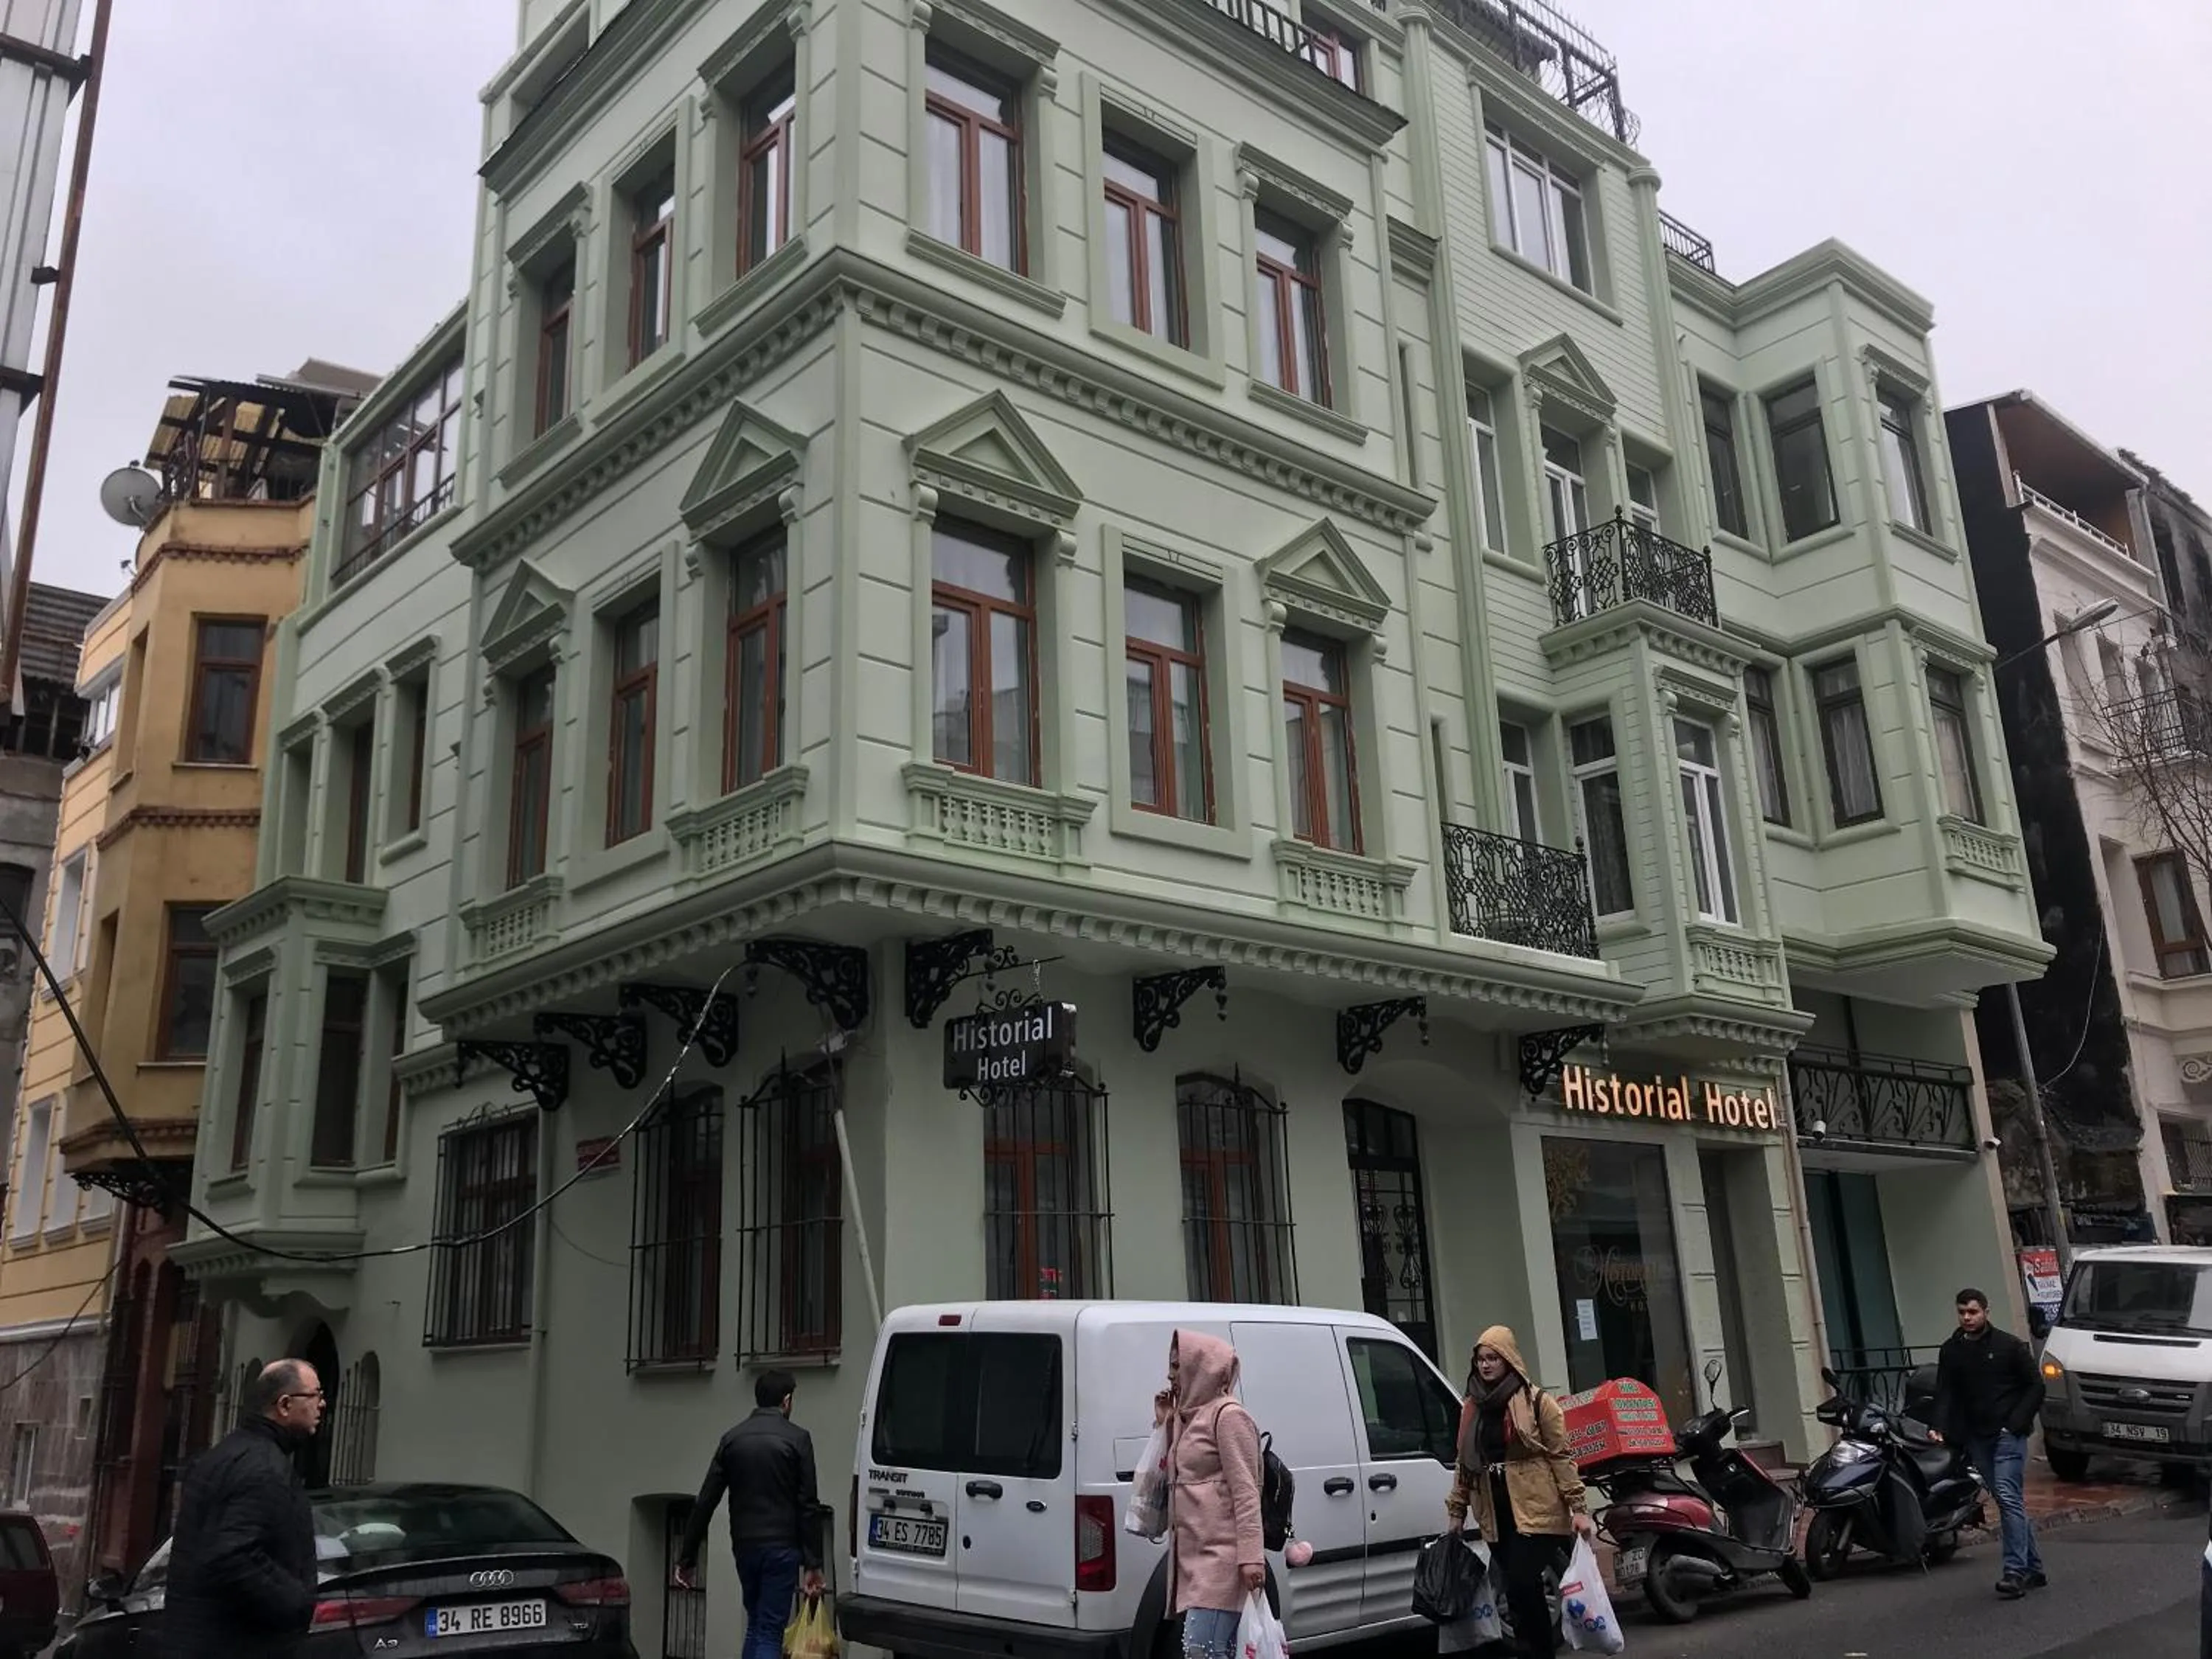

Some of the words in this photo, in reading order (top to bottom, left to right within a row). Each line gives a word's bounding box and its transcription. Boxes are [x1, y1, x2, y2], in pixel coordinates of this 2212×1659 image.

[953, 1006, 1053, 1052] Historial
[977, 1050, 1026, 1082] Hotel
[1562, 1064, 1691, 1121] Historial
[1704, 1082, 1777, 1130] Hotel
[869, 1469, 908, 1484] TRANSIT
[877, 1520, 889, 1540] 34
[895, 1521, 908, 1543] ES
[438, 1611, 461, 1632] 34
[470, 1607, 493, 1630] RE
[500, 1604, 543, 1627] 8966
